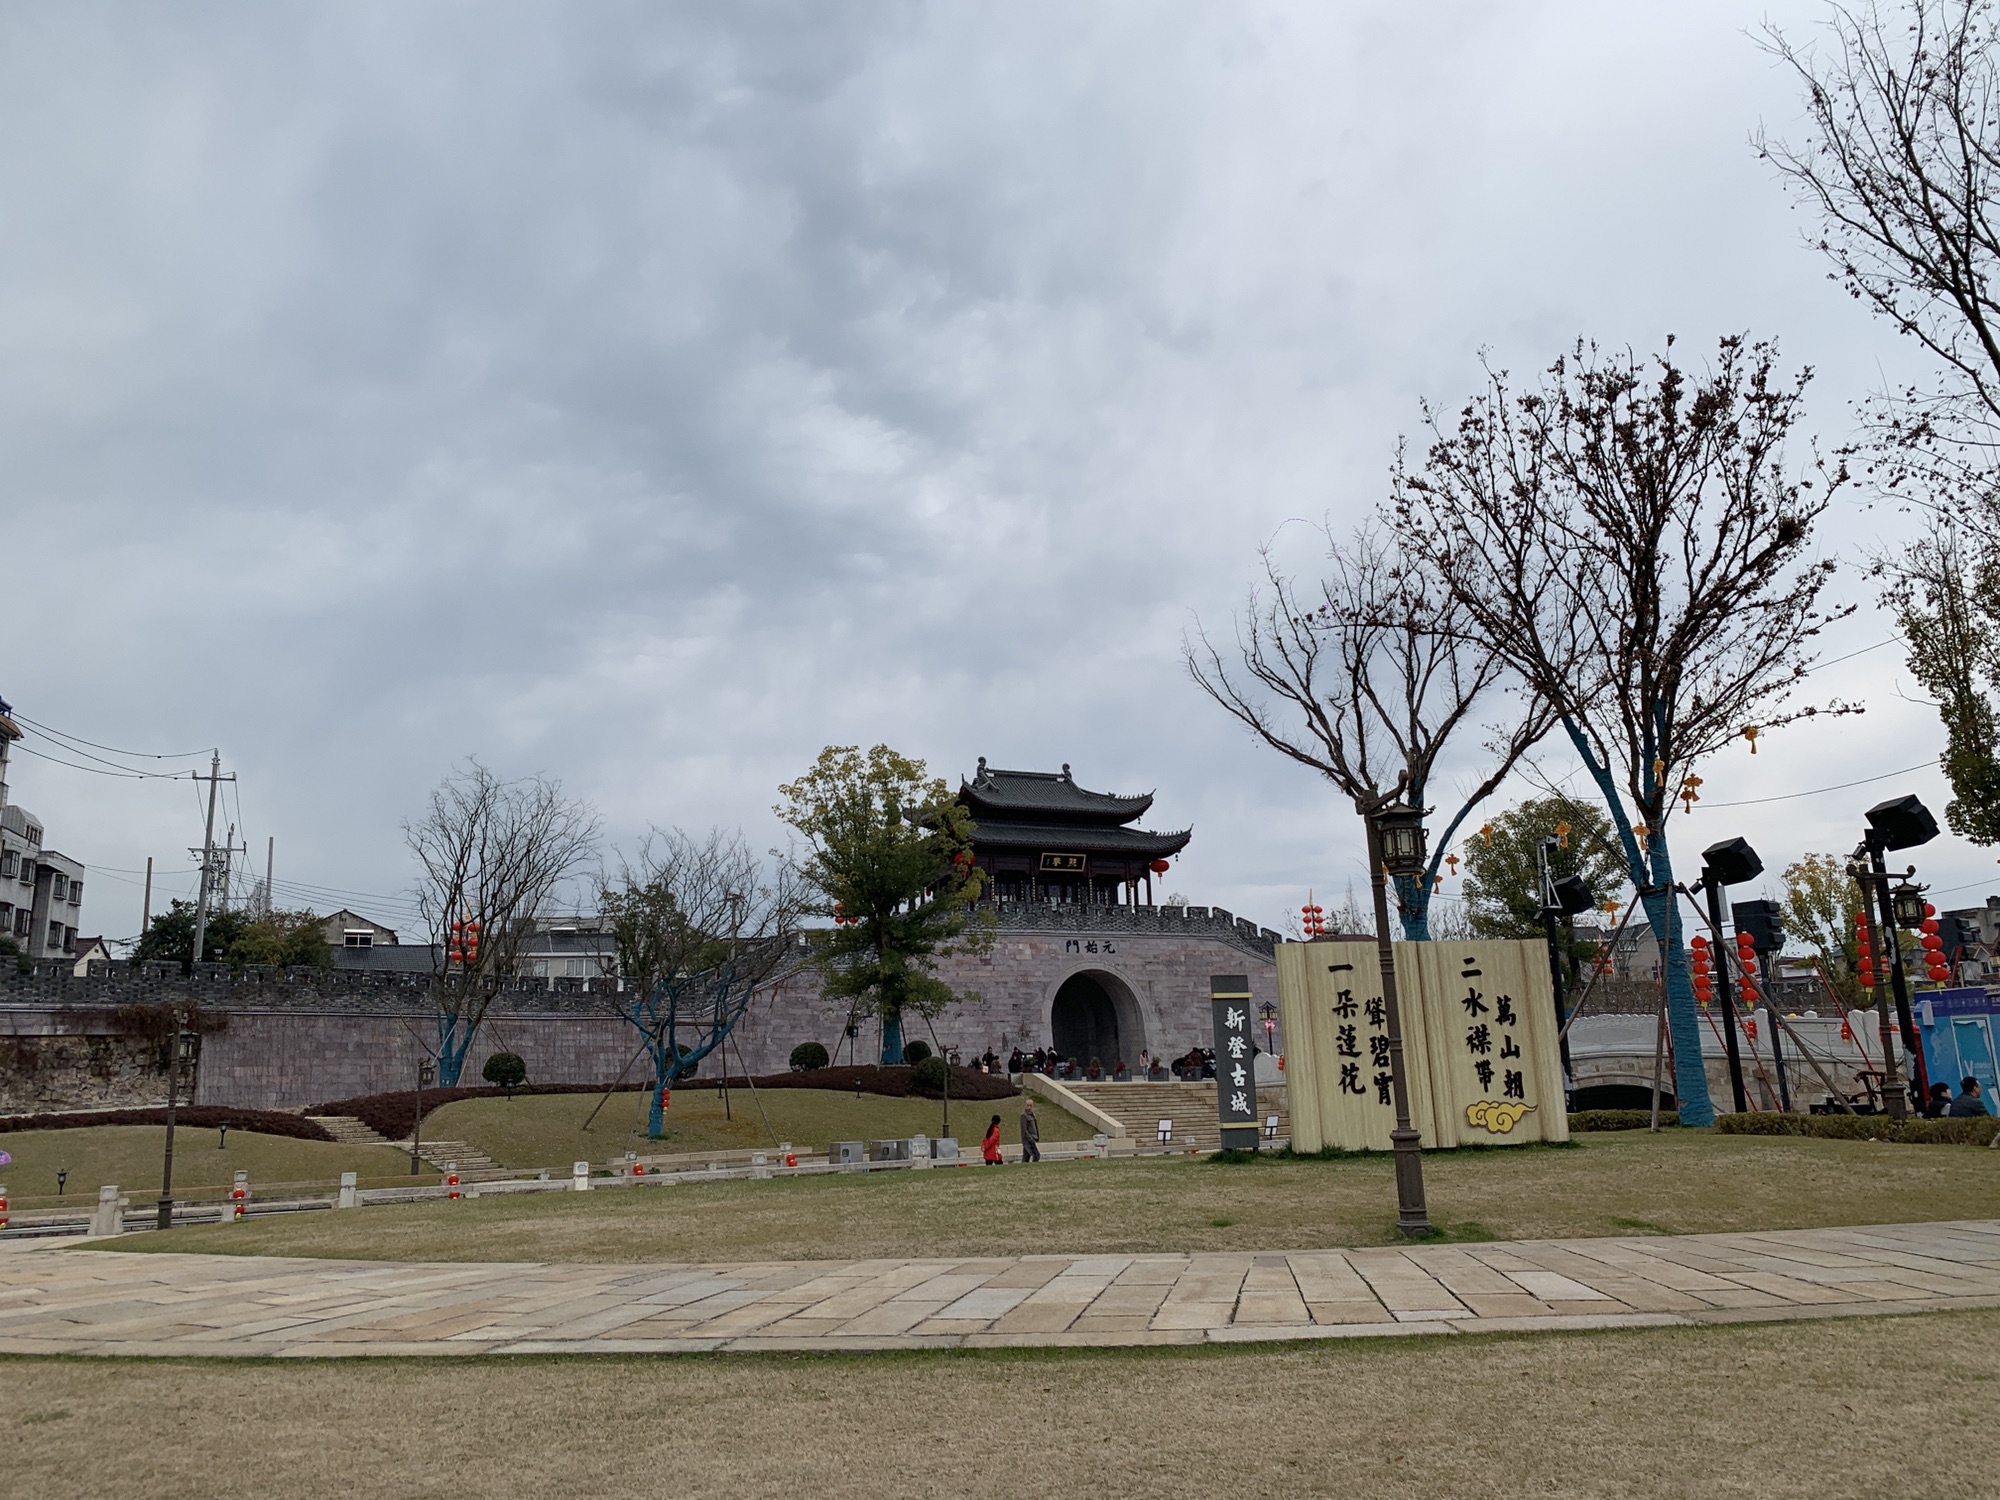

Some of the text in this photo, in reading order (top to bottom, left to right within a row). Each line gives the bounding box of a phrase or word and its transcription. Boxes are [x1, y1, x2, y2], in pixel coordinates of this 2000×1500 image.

[1224, 1006, 1251, 1115] 新登古城
[1328, 963, 1366, 1095] 一朵蓮花
[1461, 957, 1495, 1093] 二水襟帶
[1495, 994, 1525, 1099] 萬山朝
